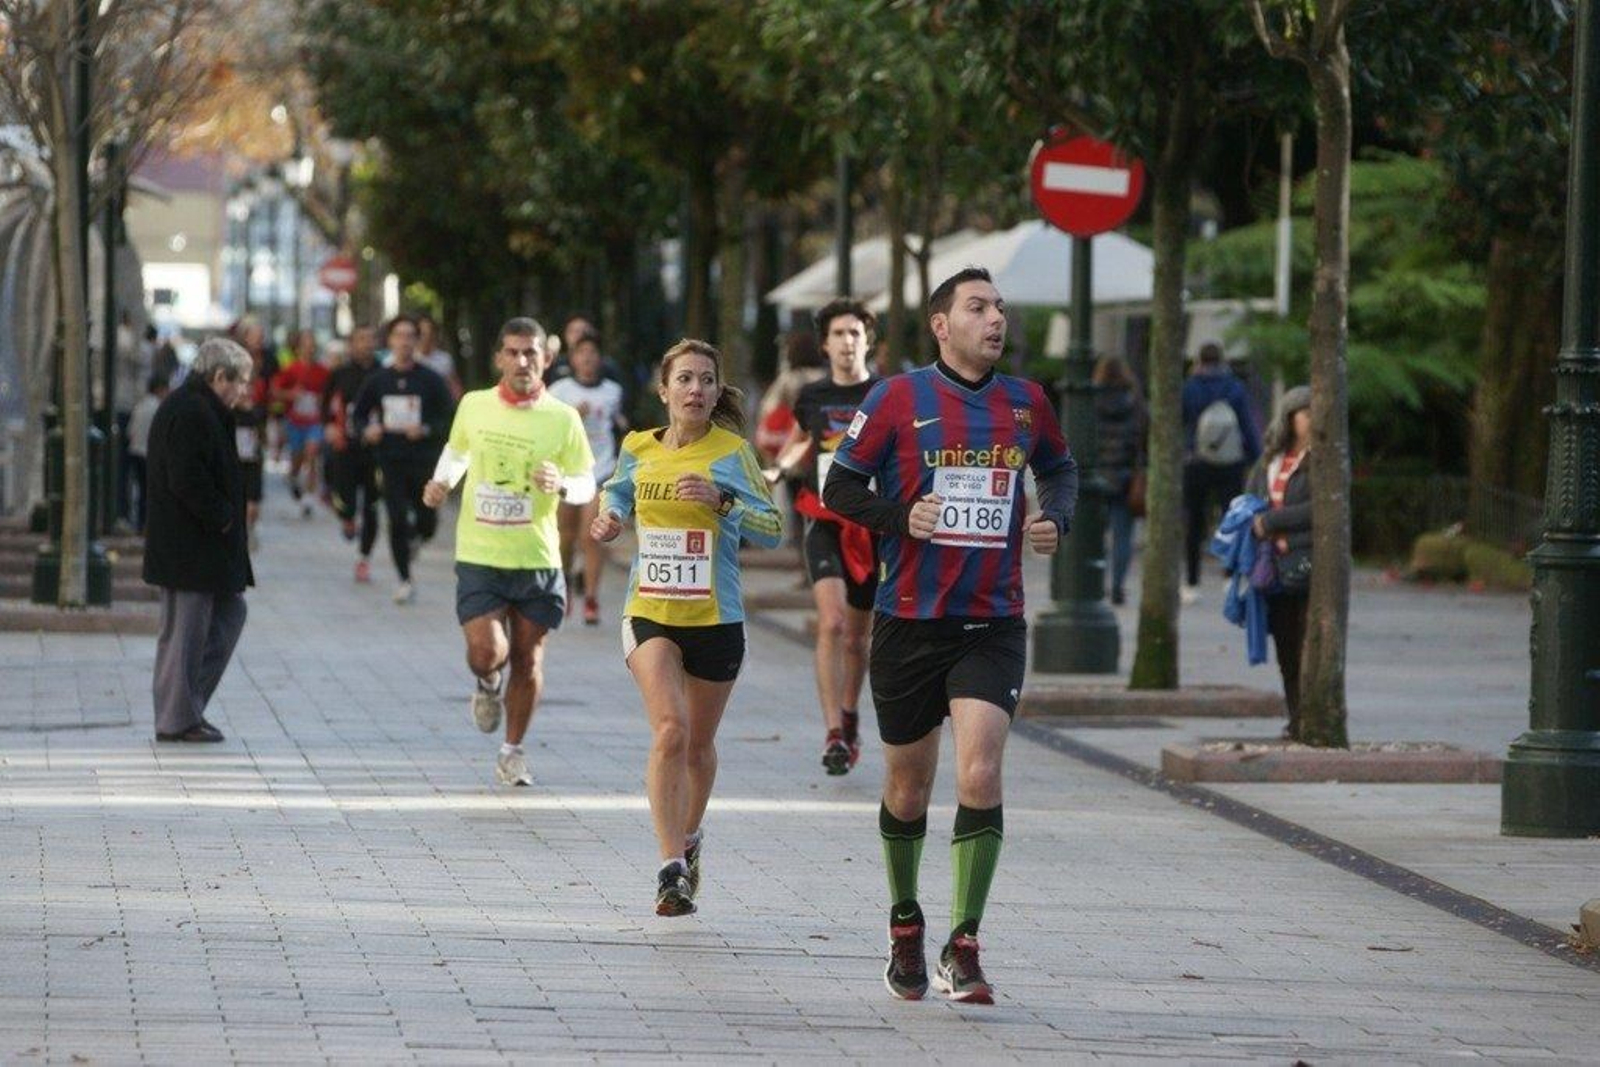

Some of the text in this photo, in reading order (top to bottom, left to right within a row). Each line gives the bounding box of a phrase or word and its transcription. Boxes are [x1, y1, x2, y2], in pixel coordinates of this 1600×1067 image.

[924, 443, 1002, 468] unicef
[945, 473, 986, 482] CONCELLO
[949, 481, 982, 490] DE VIGO
[638, 482, 679, 500] THLE
[481, 500, 524, 517] 0799
[943, 505, 1004, 531] 0186
[646, 533, 682, 541] CONCELLO
[650, 541, 658, 549] DE
[647, 562, 696, 583] 0511
